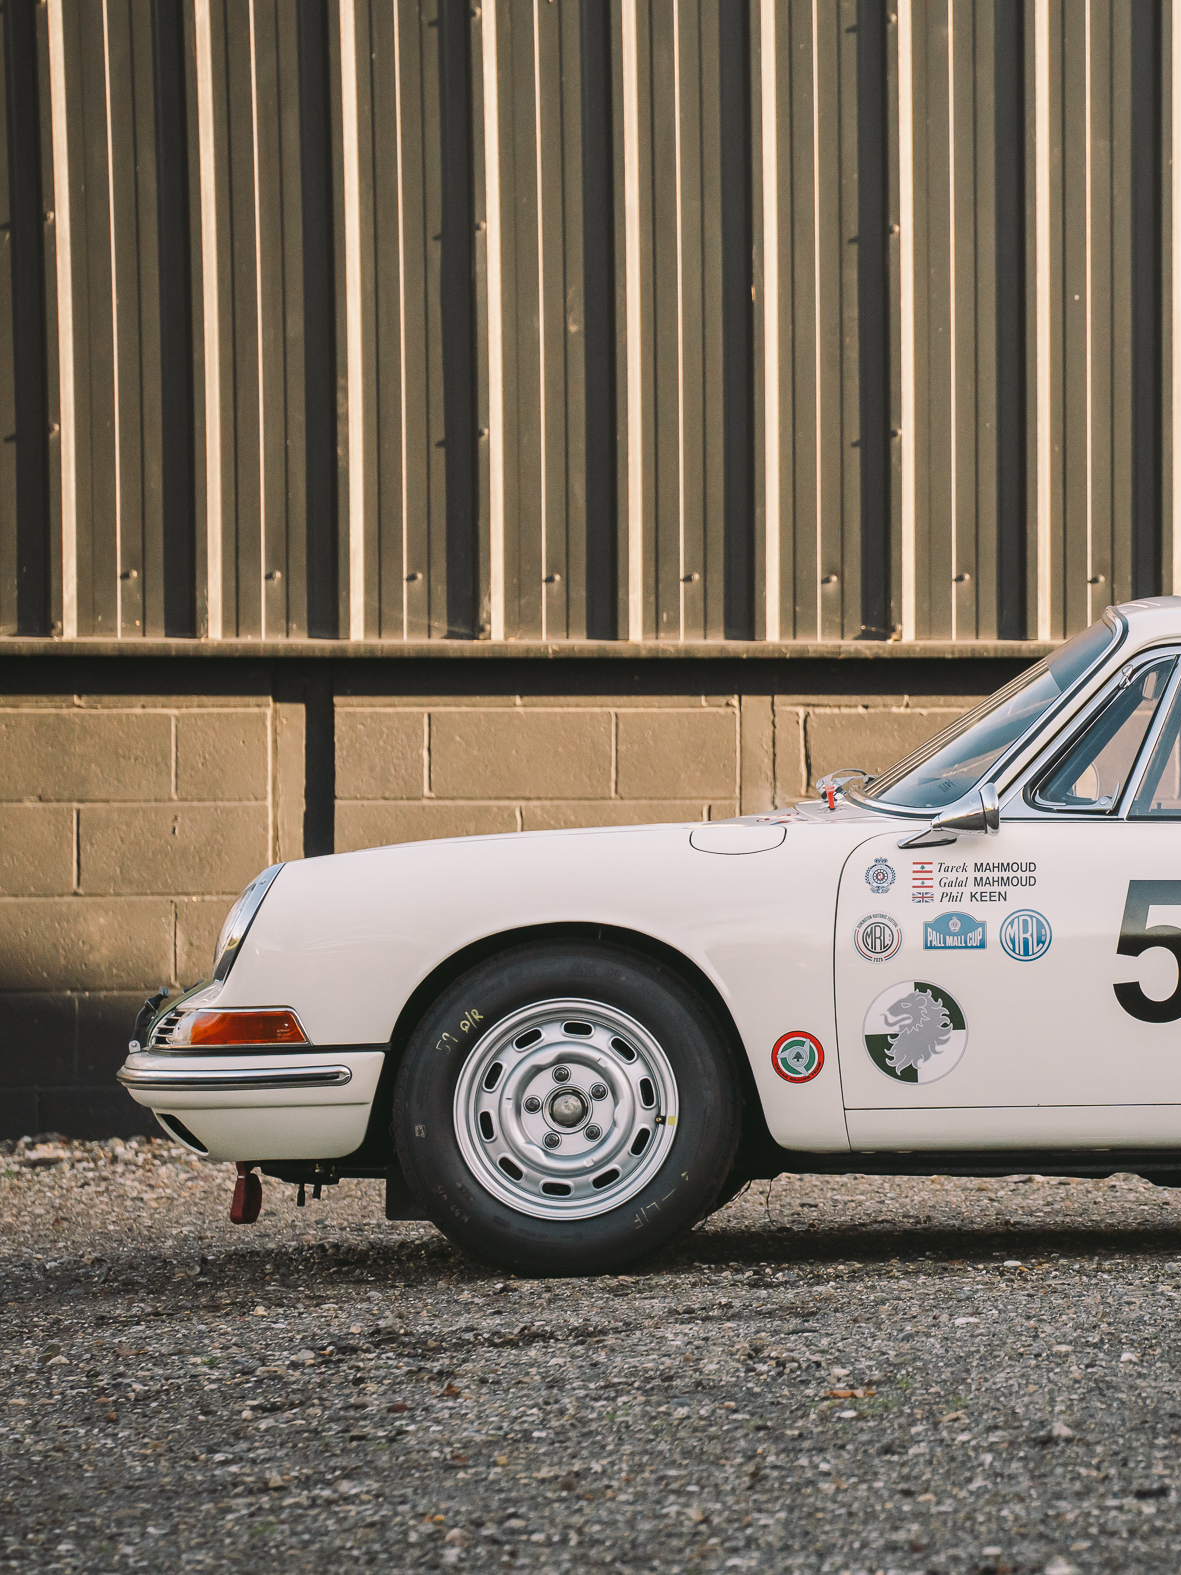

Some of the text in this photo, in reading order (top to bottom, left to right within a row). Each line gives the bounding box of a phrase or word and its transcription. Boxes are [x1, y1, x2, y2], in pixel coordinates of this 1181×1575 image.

[938, 862, 1037, 873] Tarek MAHMOUD
[939, 876, 1037, 888] Galal MAHMOUD
[939, 891, 1008, 903] Phil KEEN
[865, 925, 889, 951] MRL
[927, 926, 983, 946] PALL MALL CUP
[1006, 915, 1043, 955] MRL
[774, 1062, 789, 1079] CEDAR
[811, 1061, 822, 1076] TEAM
